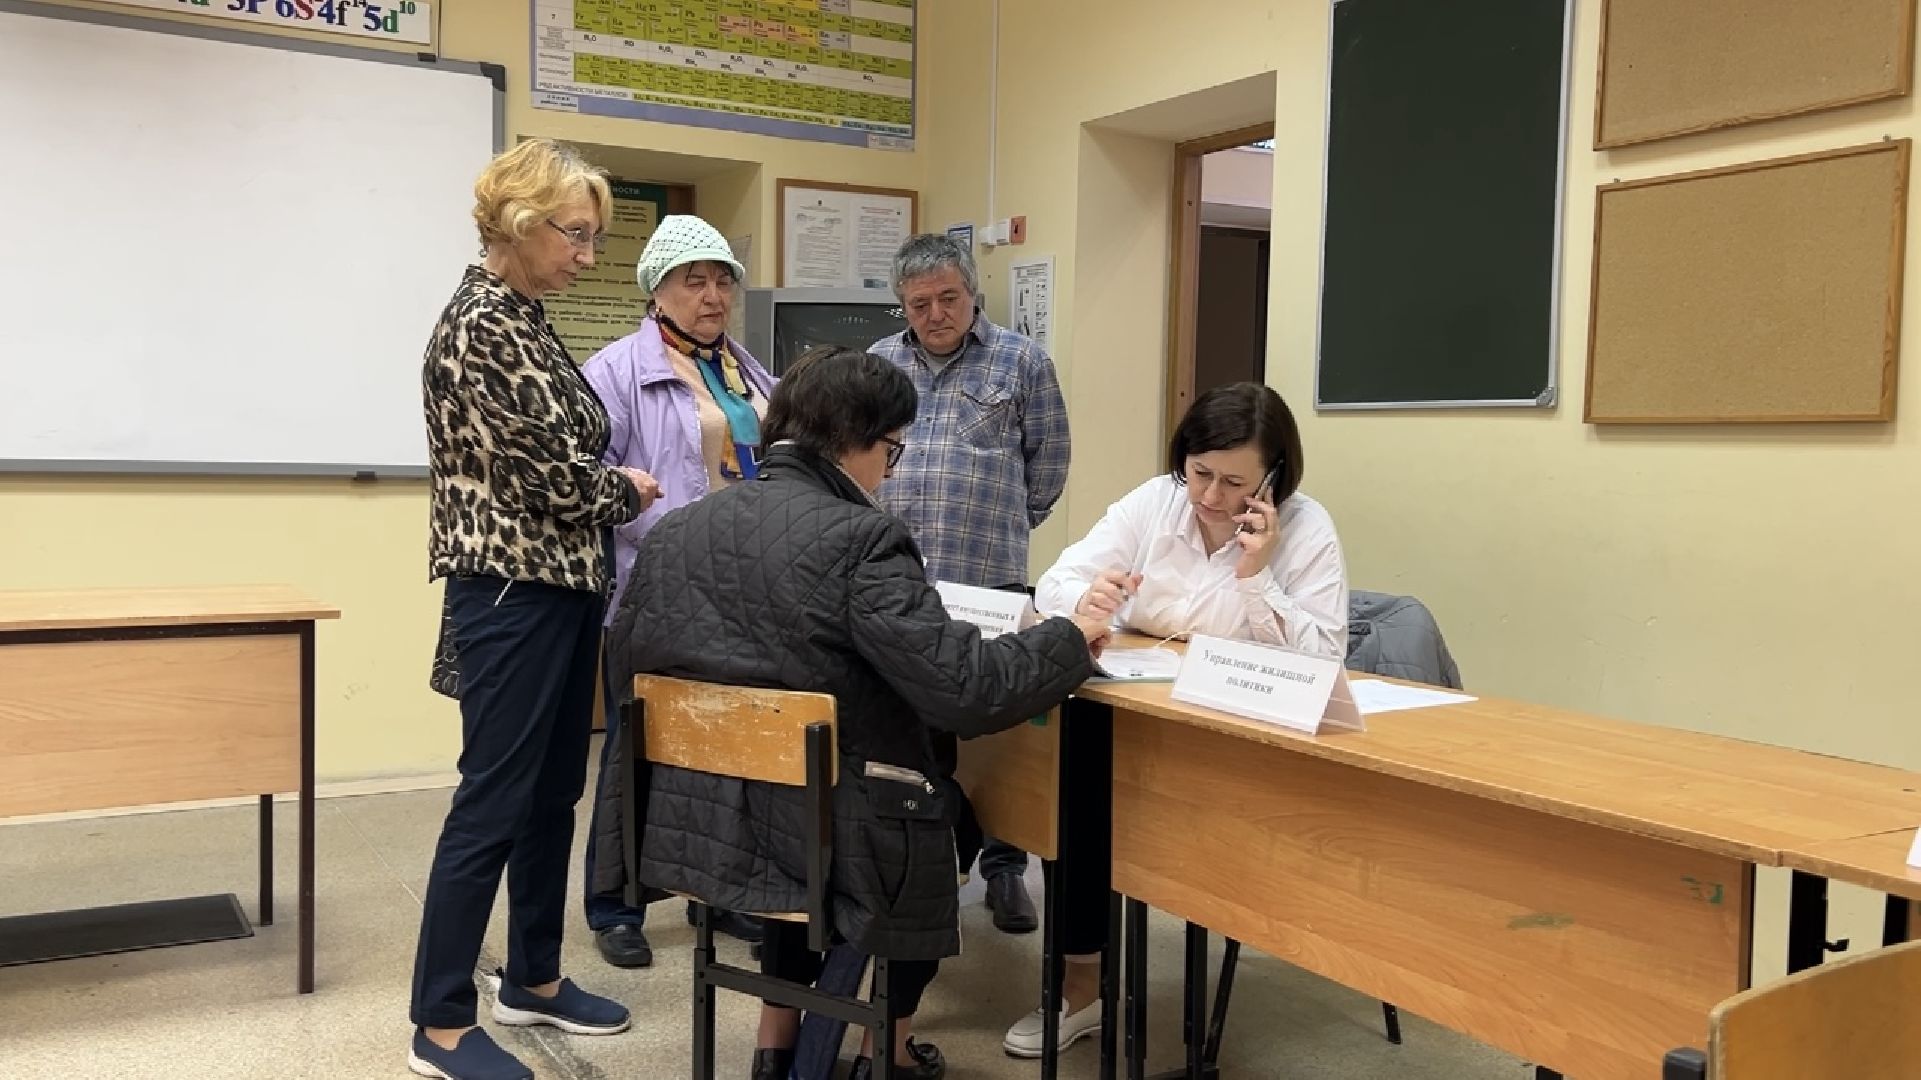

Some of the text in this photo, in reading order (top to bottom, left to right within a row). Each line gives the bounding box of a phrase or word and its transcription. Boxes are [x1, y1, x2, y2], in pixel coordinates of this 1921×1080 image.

[612, 186, 641, 195] НОСТИ
[1204, 649, 1259, 673] Управление
[1225, 676, 1275, 696] политики
